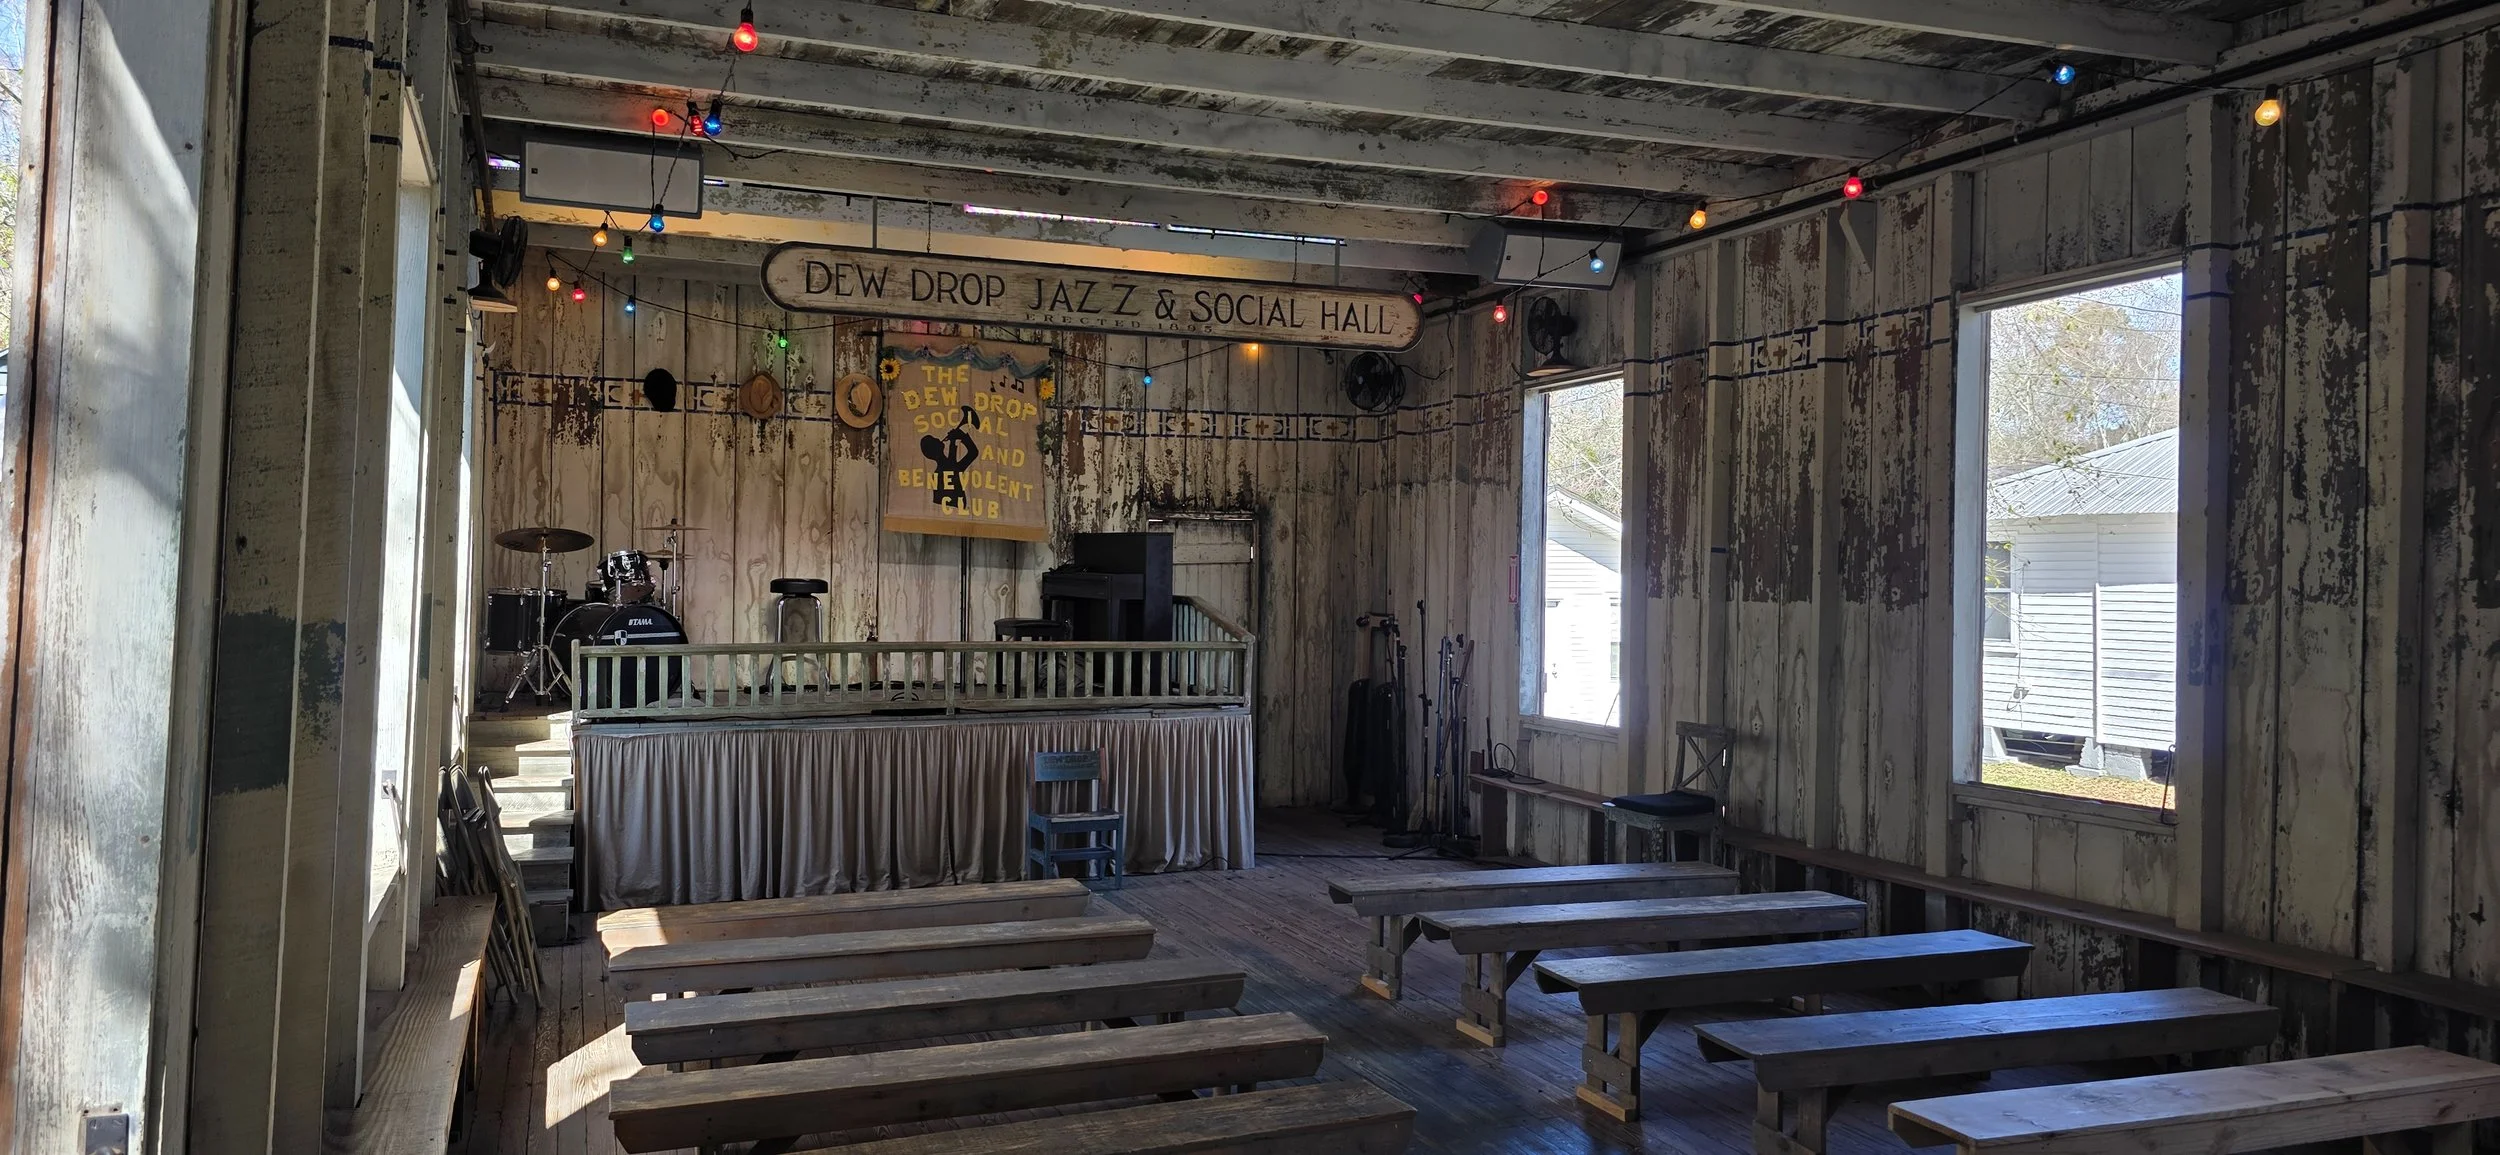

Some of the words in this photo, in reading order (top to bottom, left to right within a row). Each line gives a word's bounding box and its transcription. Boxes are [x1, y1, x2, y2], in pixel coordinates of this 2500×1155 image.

[804, 260, 889, 299] DEW
[910, 268, 1006, 307] DROP
[1027, 278, 1142, 317] JAZZ
[1154, 288, 1179, 321] &
[1189, 290, 1305, 329] SOCIAL
[1320, 300, 1395, 335] HALL
[1025, 313, 1141, 329] ERECTED
[1157, 322, 1213, 334] 1895
[921, 364, 970, 385] THE
[902, 386, 959, 412] DEW
[973, 391, 1038, 421] DROP
[913, 408, 1009, 437] SOCIAL
[981, 444, 1026, 468] AND
[898, 468, 1034, 502] BENEVOLENT
[941, 496, 1000, 519] CLUB
